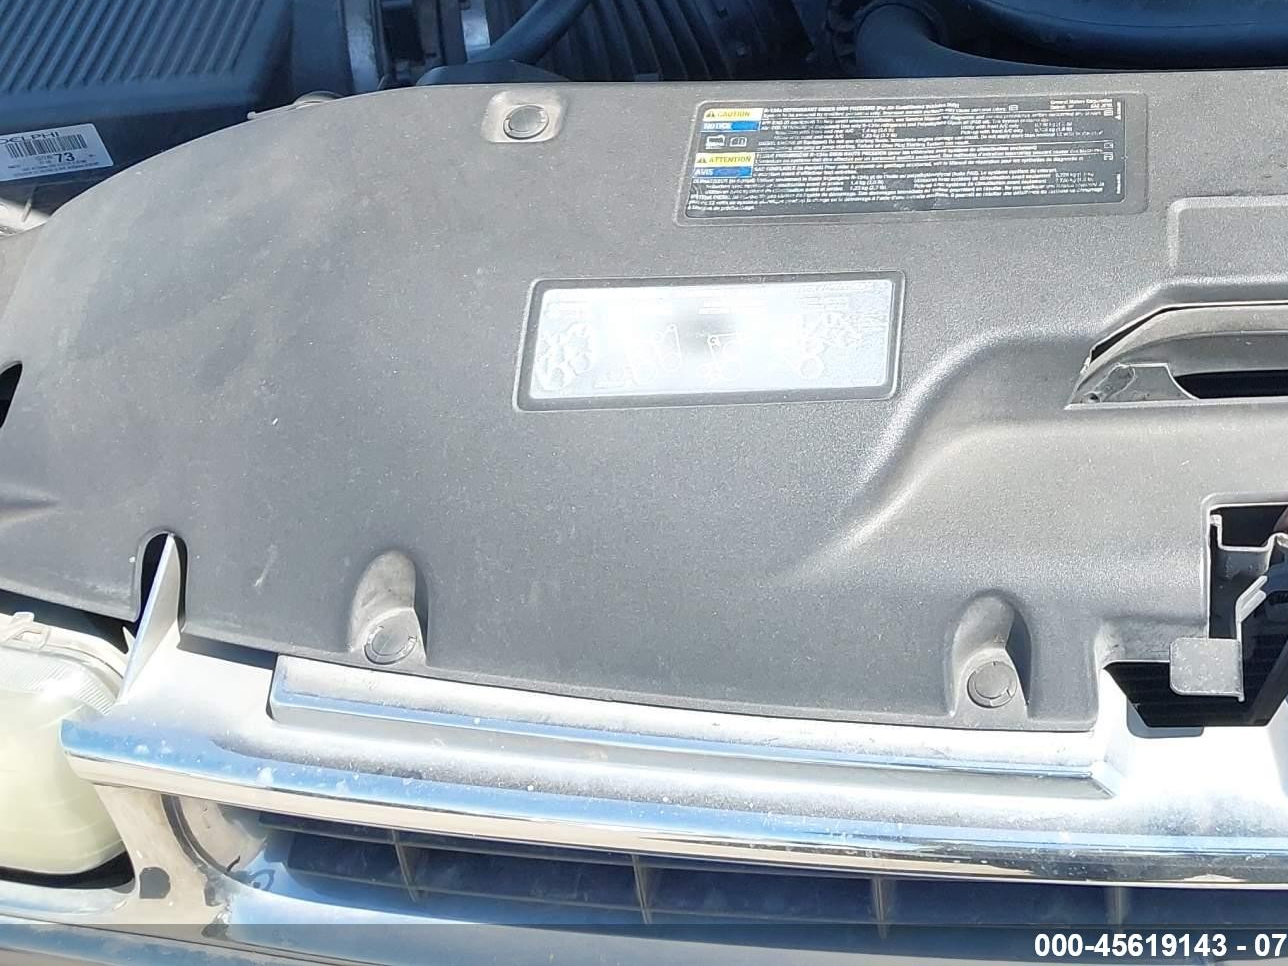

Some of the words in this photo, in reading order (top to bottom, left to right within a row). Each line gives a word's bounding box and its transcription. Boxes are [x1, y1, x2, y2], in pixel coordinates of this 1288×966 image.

[703, 122, 732, 130] NOTICE
[54, 152, 76, 163] 73
[709, 155, 752, 163] ATTENTION
